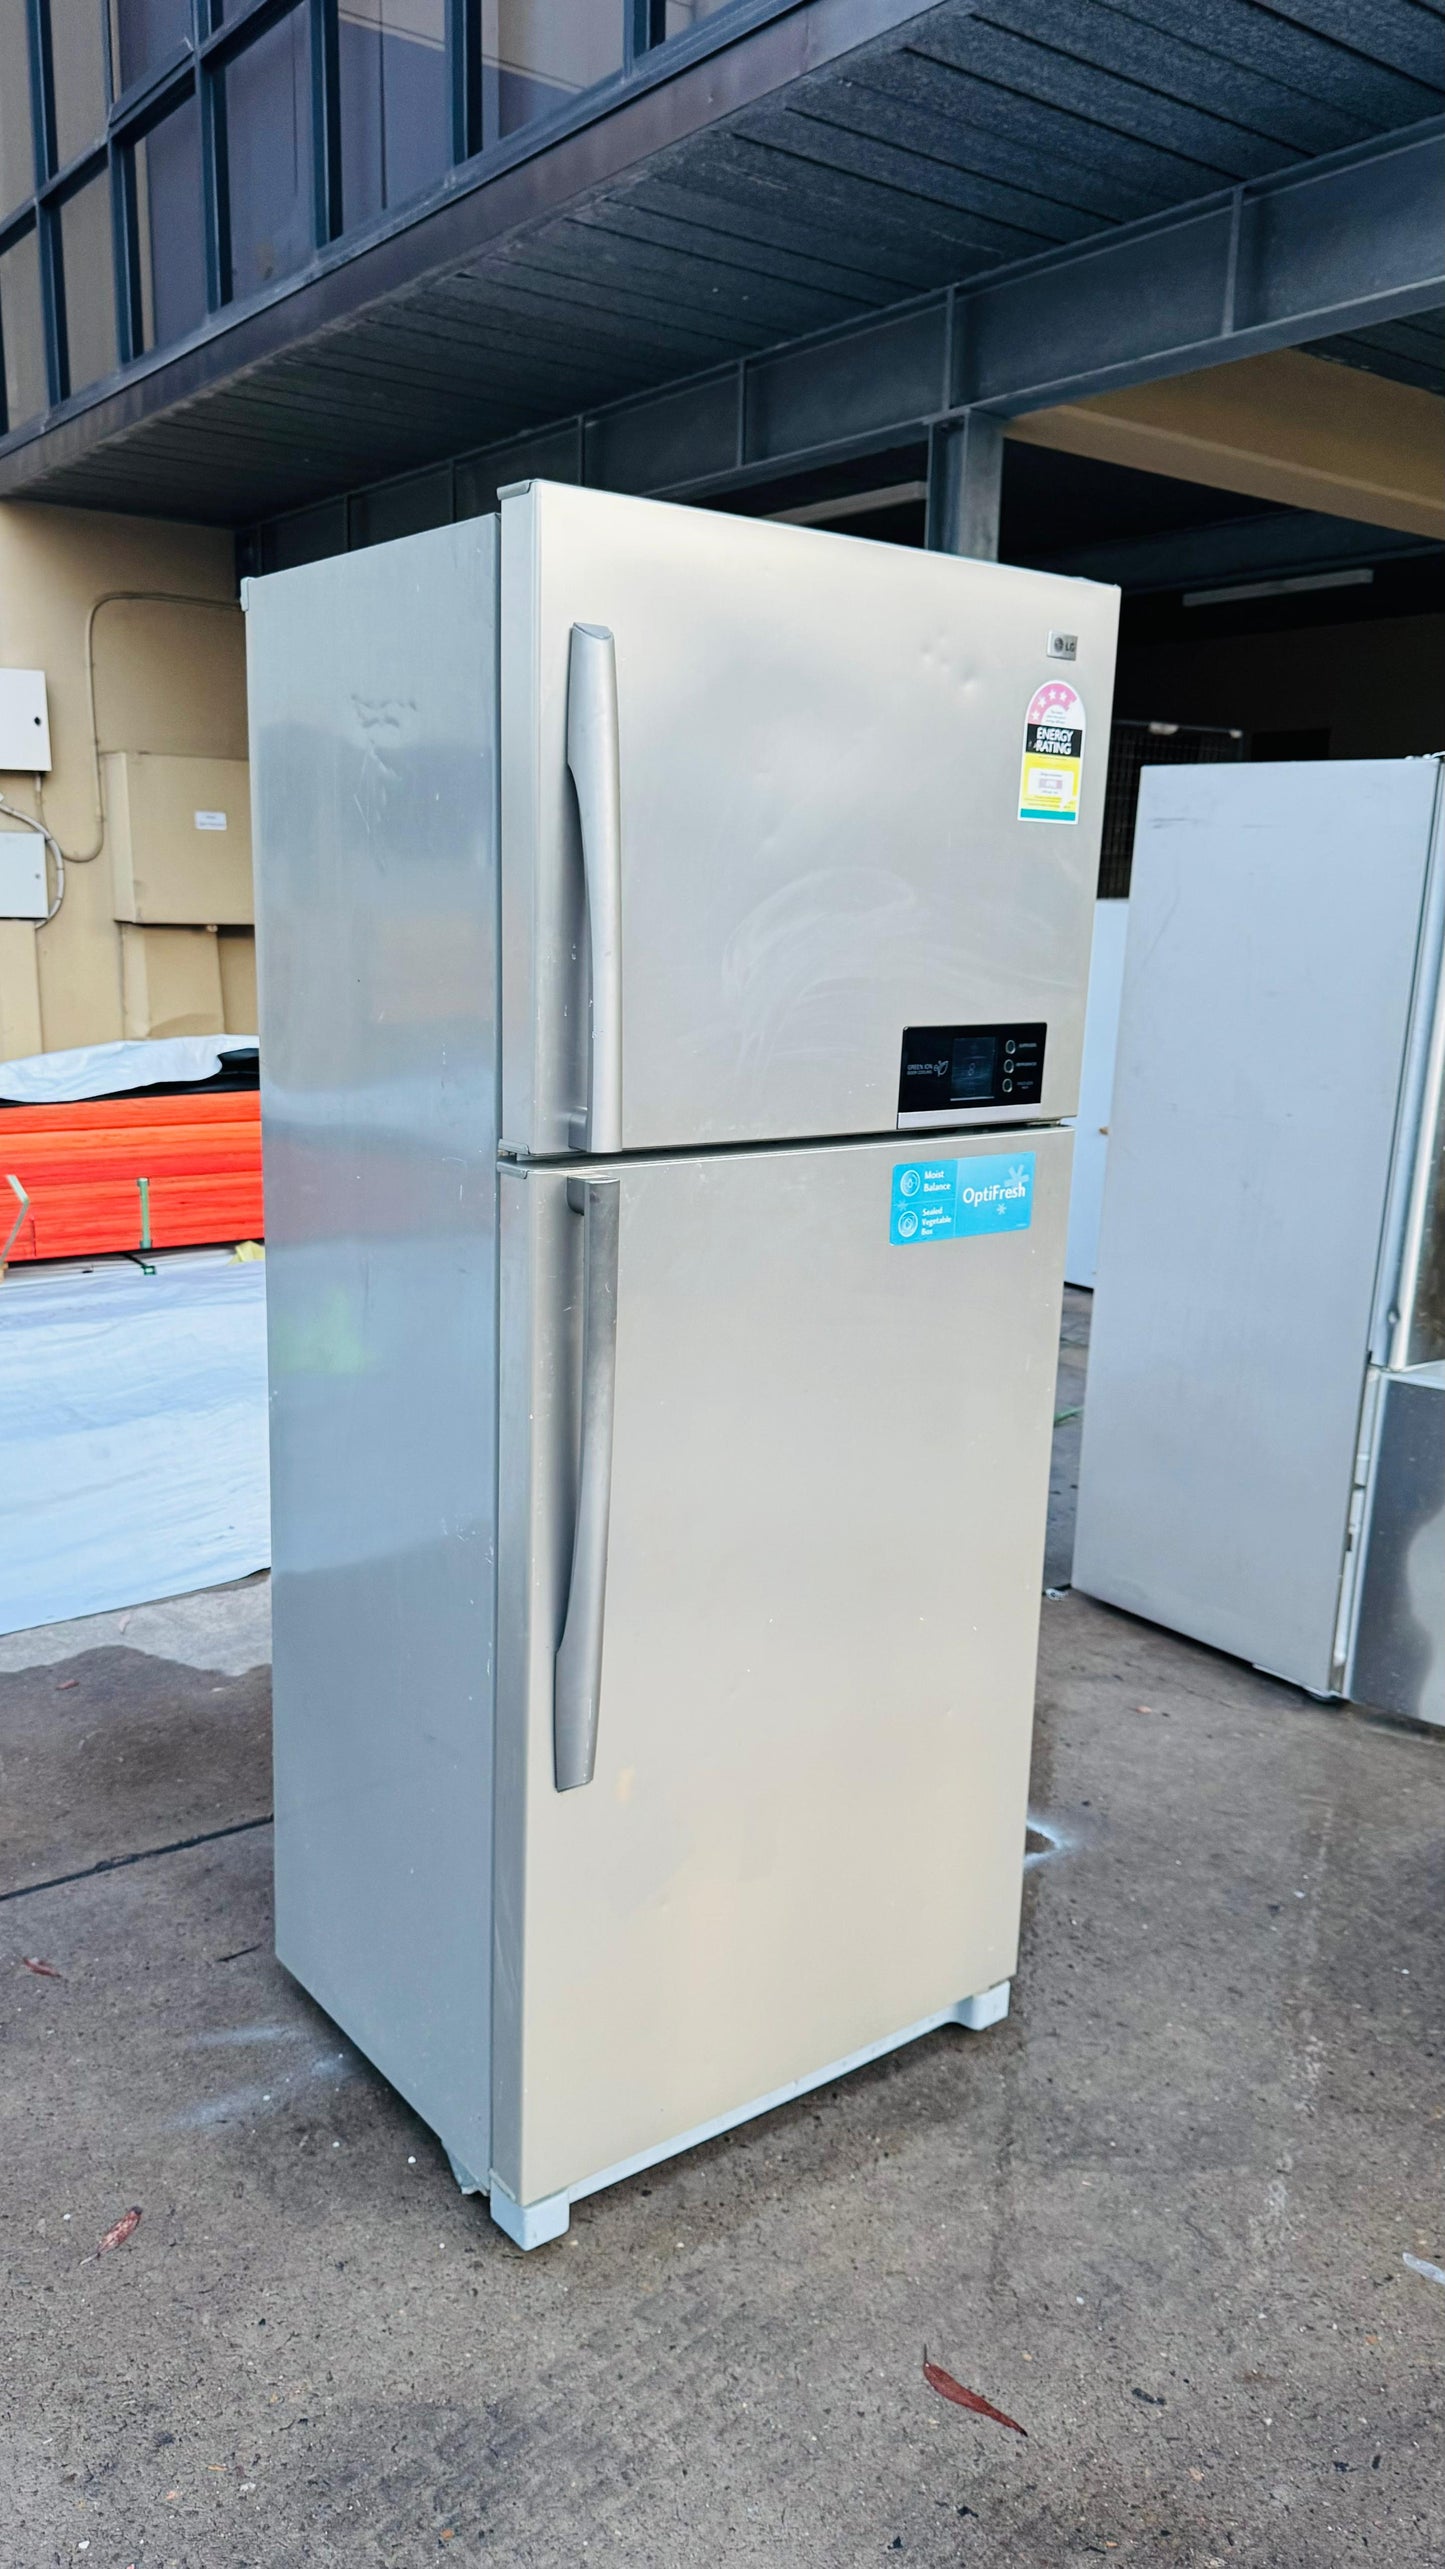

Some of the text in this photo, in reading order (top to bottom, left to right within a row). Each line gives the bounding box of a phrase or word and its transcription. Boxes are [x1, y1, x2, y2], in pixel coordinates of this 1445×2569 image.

[1036, 726, 1074, 743] ENERGY
[1035, 739, 1072, 755] RATING
[924, 1170, 944, 1179] Moist
[923, 1182, 952, 1192] Balance
[962, 1181, 1026, 1207] OptiFresh
[922, 1206, 943, 1216] Sealed
[921, 1215, 952, 1228] Vegetable
